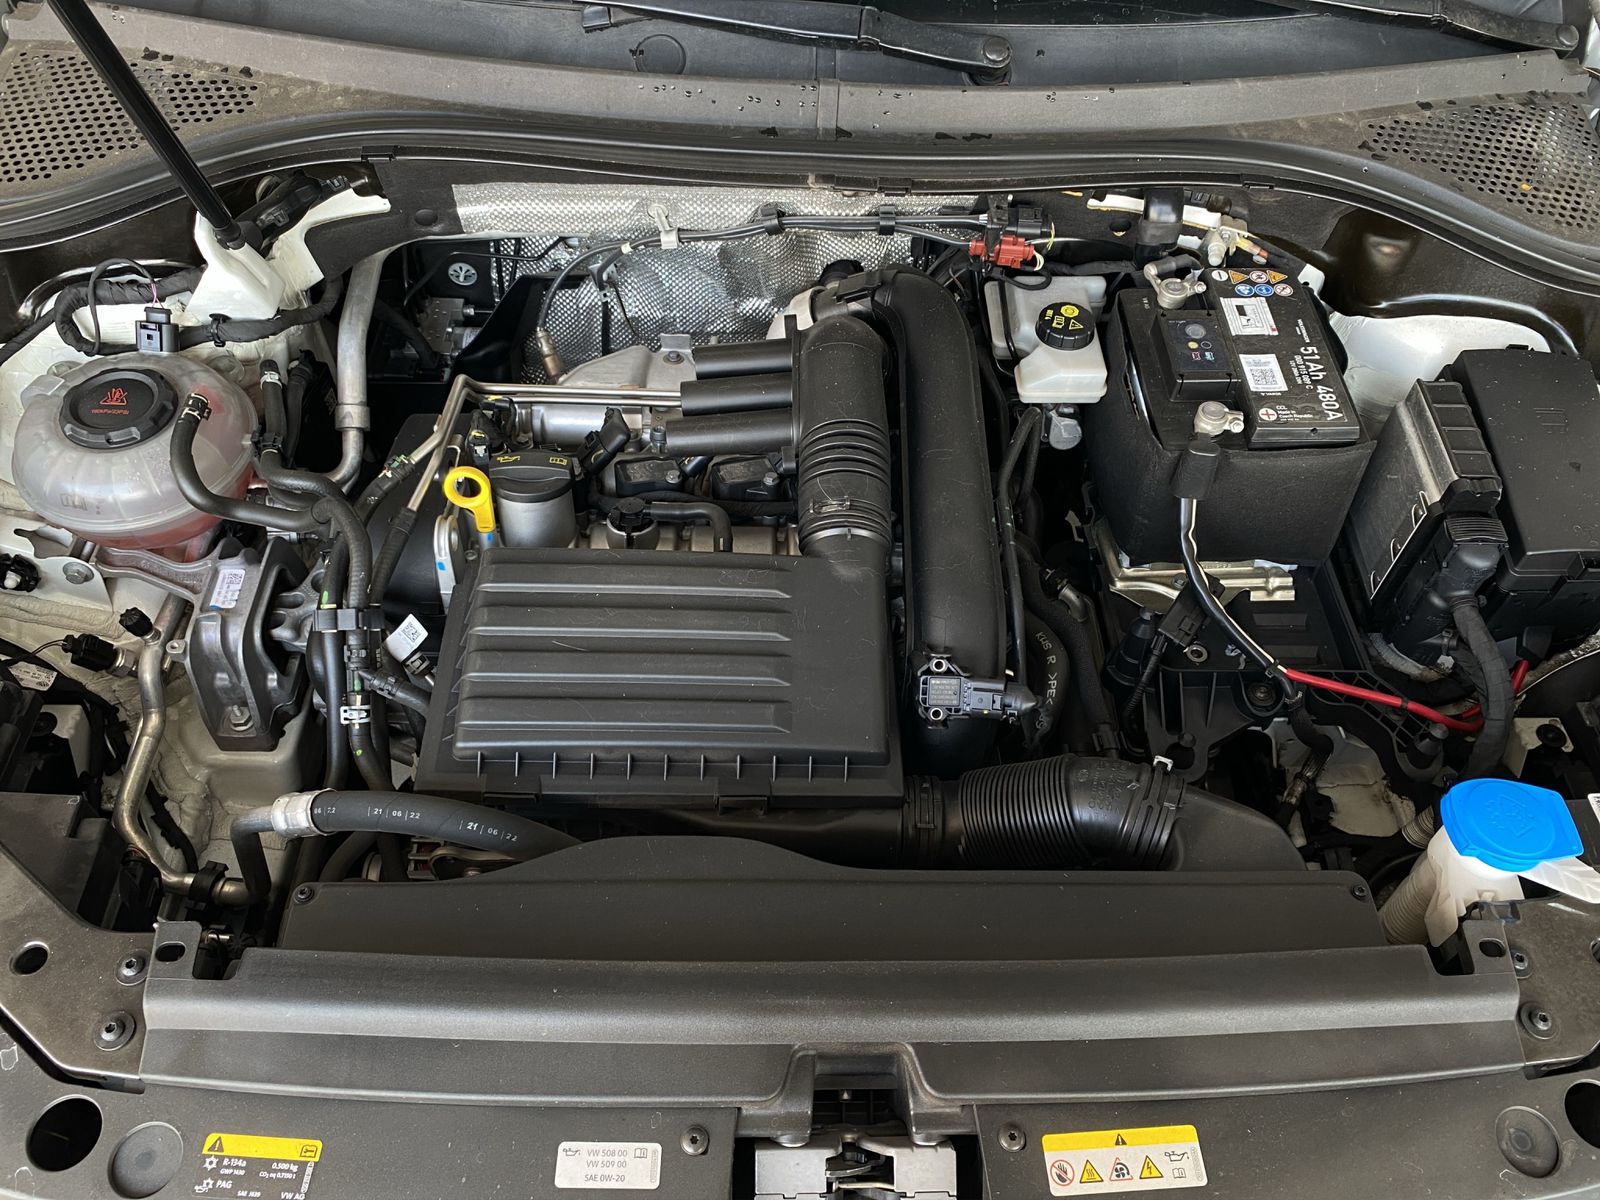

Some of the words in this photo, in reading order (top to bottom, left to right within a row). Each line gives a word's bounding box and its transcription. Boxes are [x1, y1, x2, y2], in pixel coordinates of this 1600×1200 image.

[1316, 385, 1344, 421] 480A
[373, 807, 383, 815] 21
[409, 811, 421, 819] 22
[466, 821, 479, 831] 21
[587, 1148, 600, 1157] VW
[600, 1149, 616, 1158] 508
[617, 1149, 628, 1158] 00
[222, 1158, 247, 1168] R-134a
[271, 1162, 290, 1170] 0.500
[290, 1163, 299, 1172] kg
[586, 1160, 599, 1168] VW
[600, 1160, 616, 1168] 509
[616, 1160, 627, 1168] 00
[584, 1174, 598, 1182] SAE
[599, 1174, 626, 1182] 0W-20
[216, 1180, 233, 1189] PAG
[280, 1192, 294, 1200] VW
